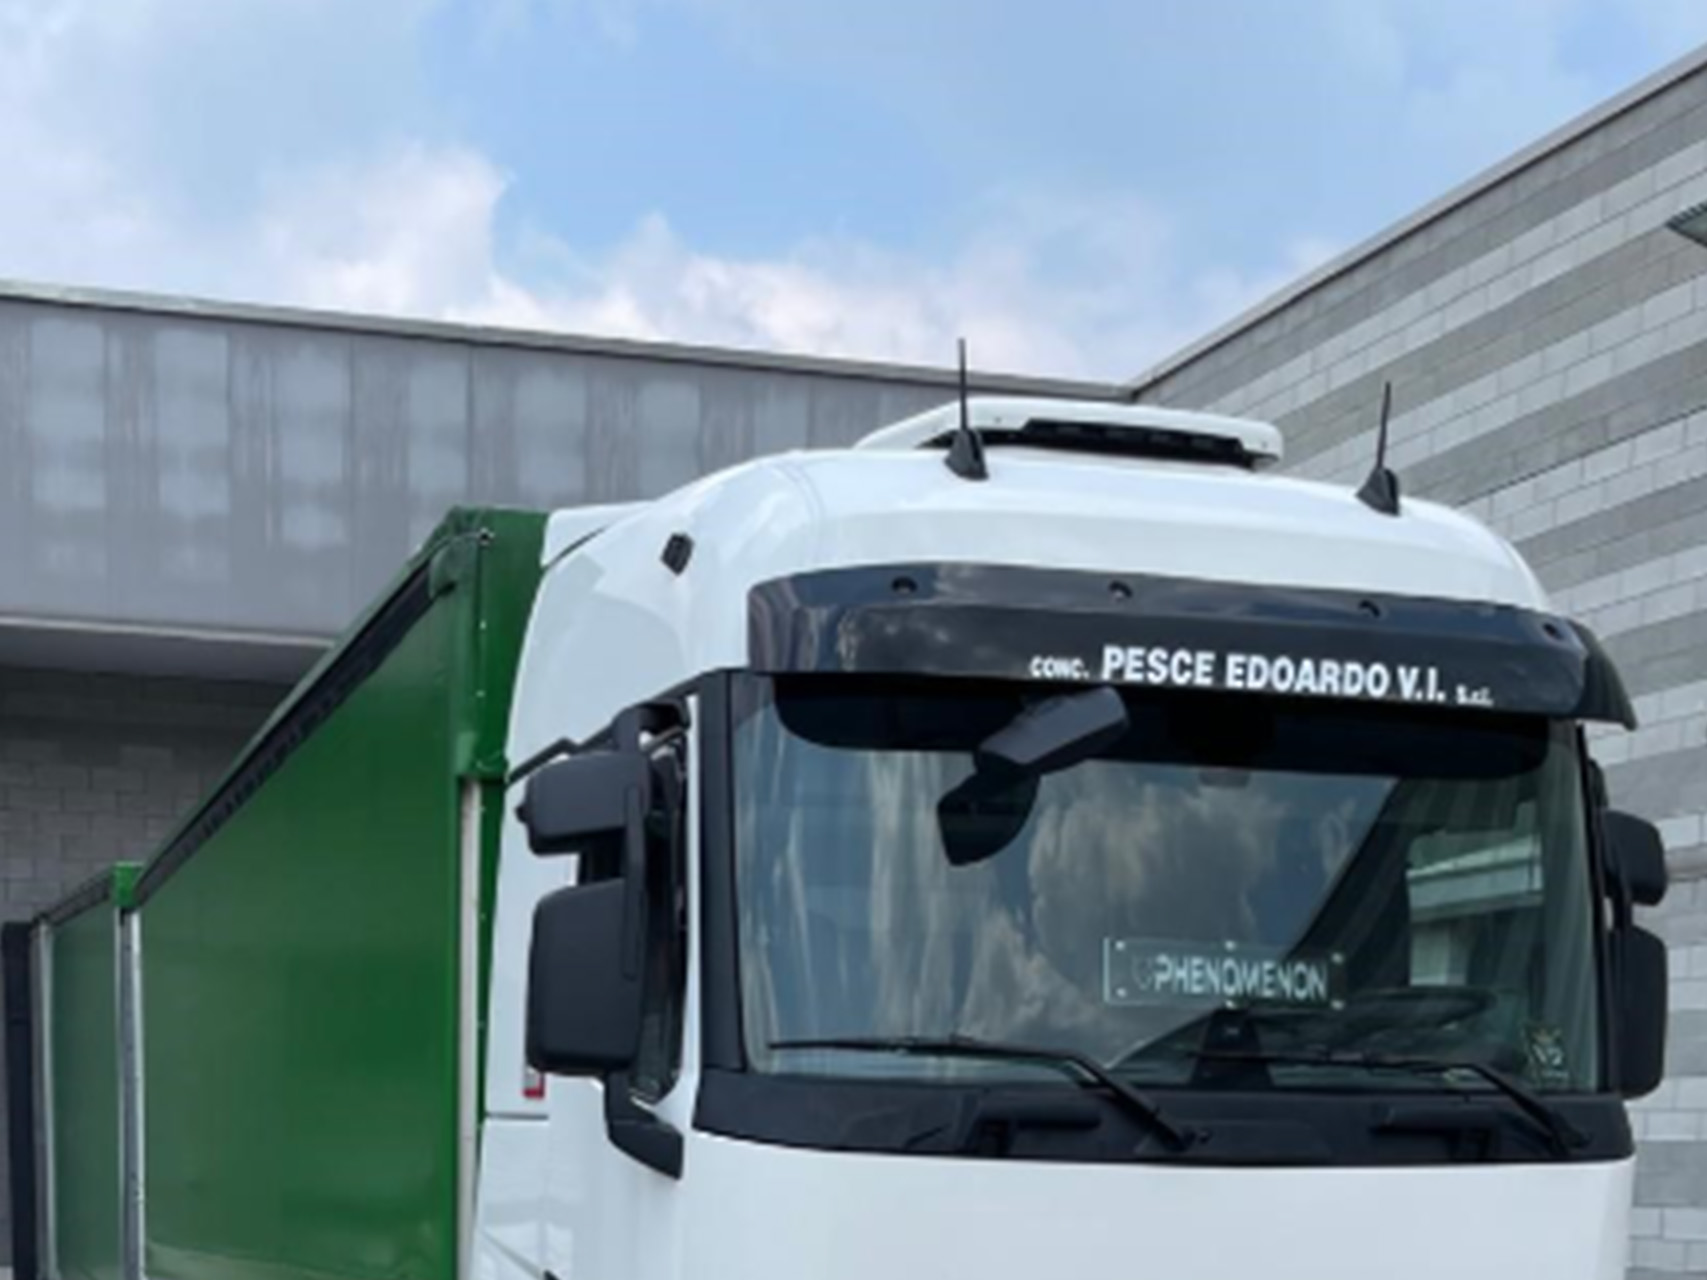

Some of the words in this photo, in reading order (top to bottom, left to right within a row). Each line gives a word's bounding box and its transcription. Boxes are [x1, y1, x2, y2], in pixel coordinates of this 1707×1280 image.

[1029, 655, 1090, 680] CONC.
[1102, 644, 1216, 687] PESCE
[1225, 653, 1391, 699] EDOARDO
[1397, 664, 1446, 702] V.I.
[1153, 953, 1328, 1000] PHENOMENON
